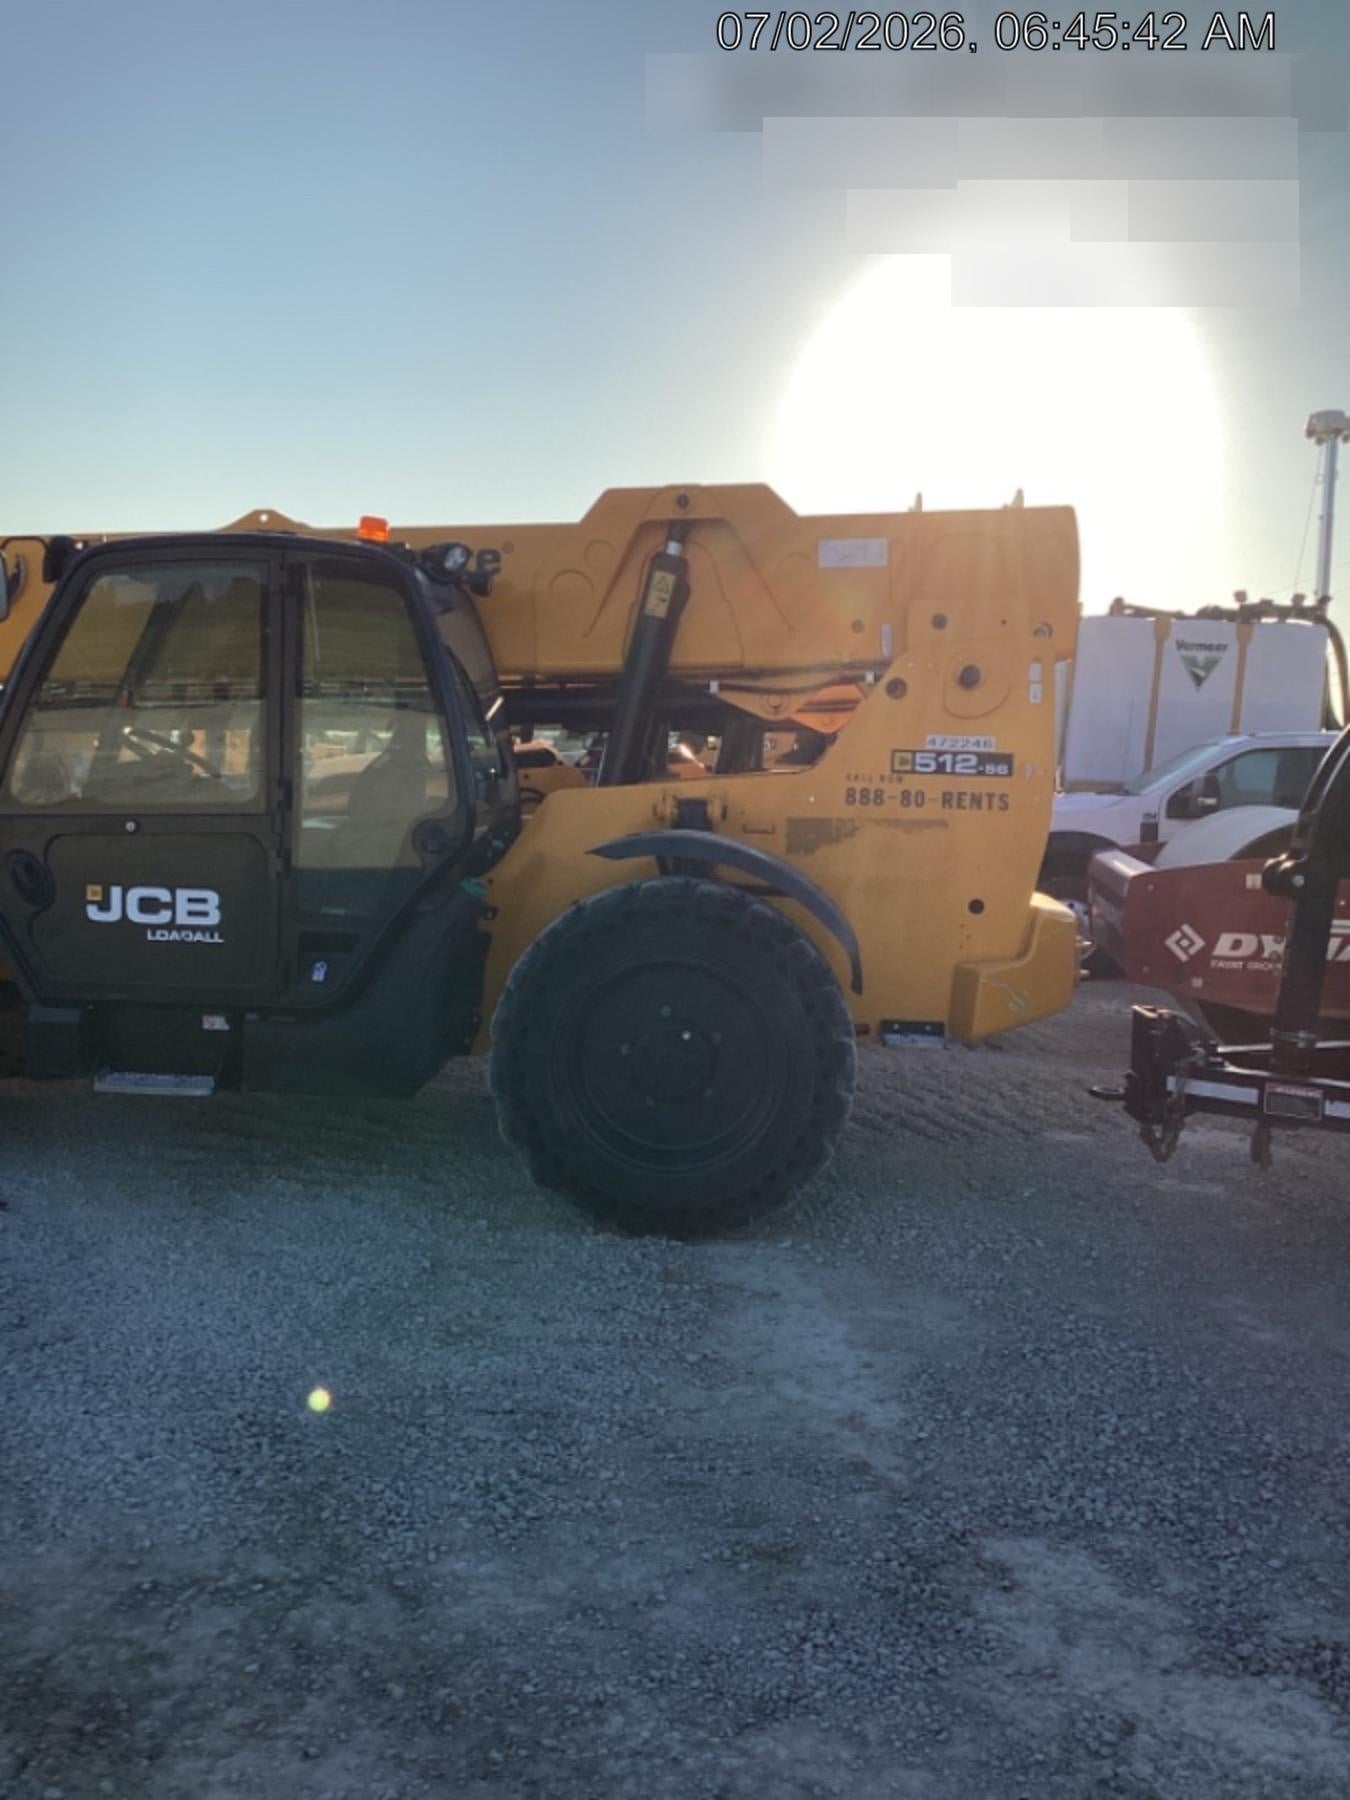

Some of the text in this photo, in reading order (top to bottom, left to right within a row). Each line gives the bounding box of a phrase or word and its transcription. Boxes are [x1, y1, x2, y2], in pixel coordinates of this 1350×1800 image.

[1175, 639, 1229, 652] Vermeer
[86, 885, 221, 925] JCB
[147, 928, 225, 943] LOADALL
